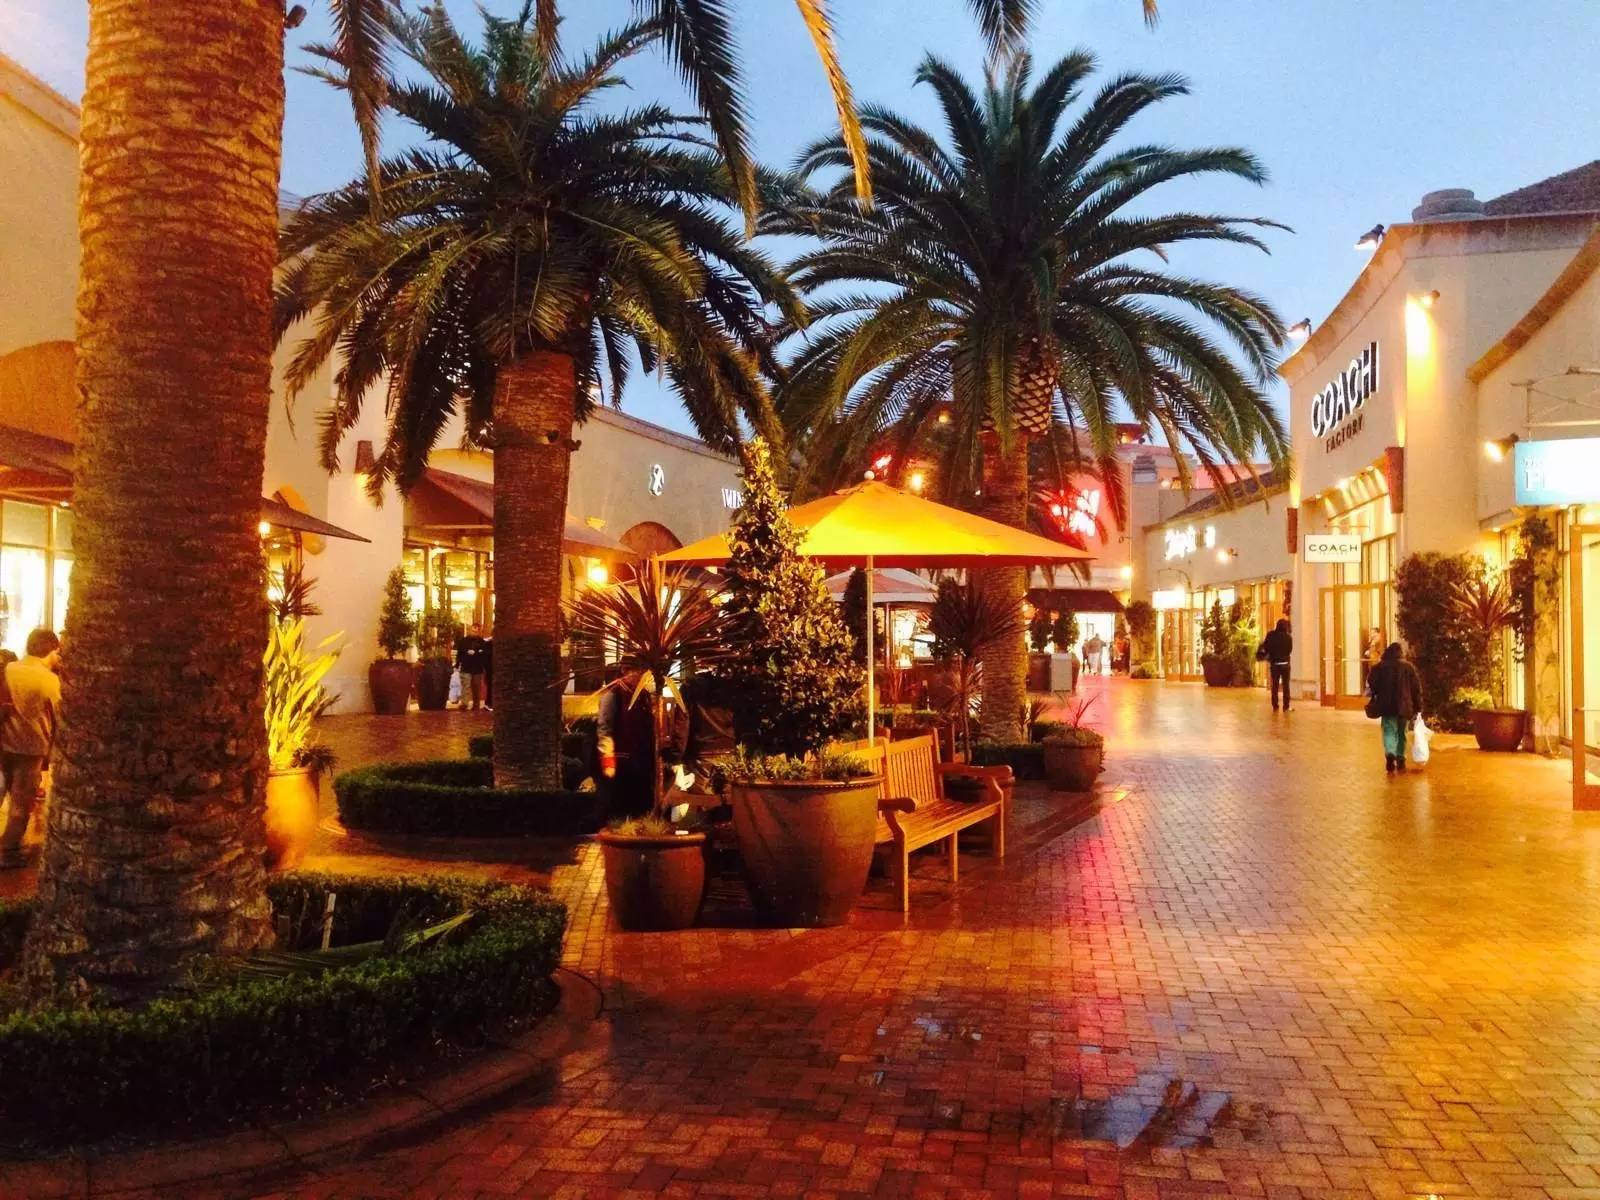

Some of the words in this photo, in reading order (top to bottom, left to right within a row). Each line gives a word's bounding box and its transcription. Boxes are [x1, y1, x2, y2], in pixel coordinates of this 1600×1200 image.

[1312, 341, 1379, 438] COACH
[1326, 414, 1363, 454] FACTORY
[1308, 543, 1358, 553] COACH
